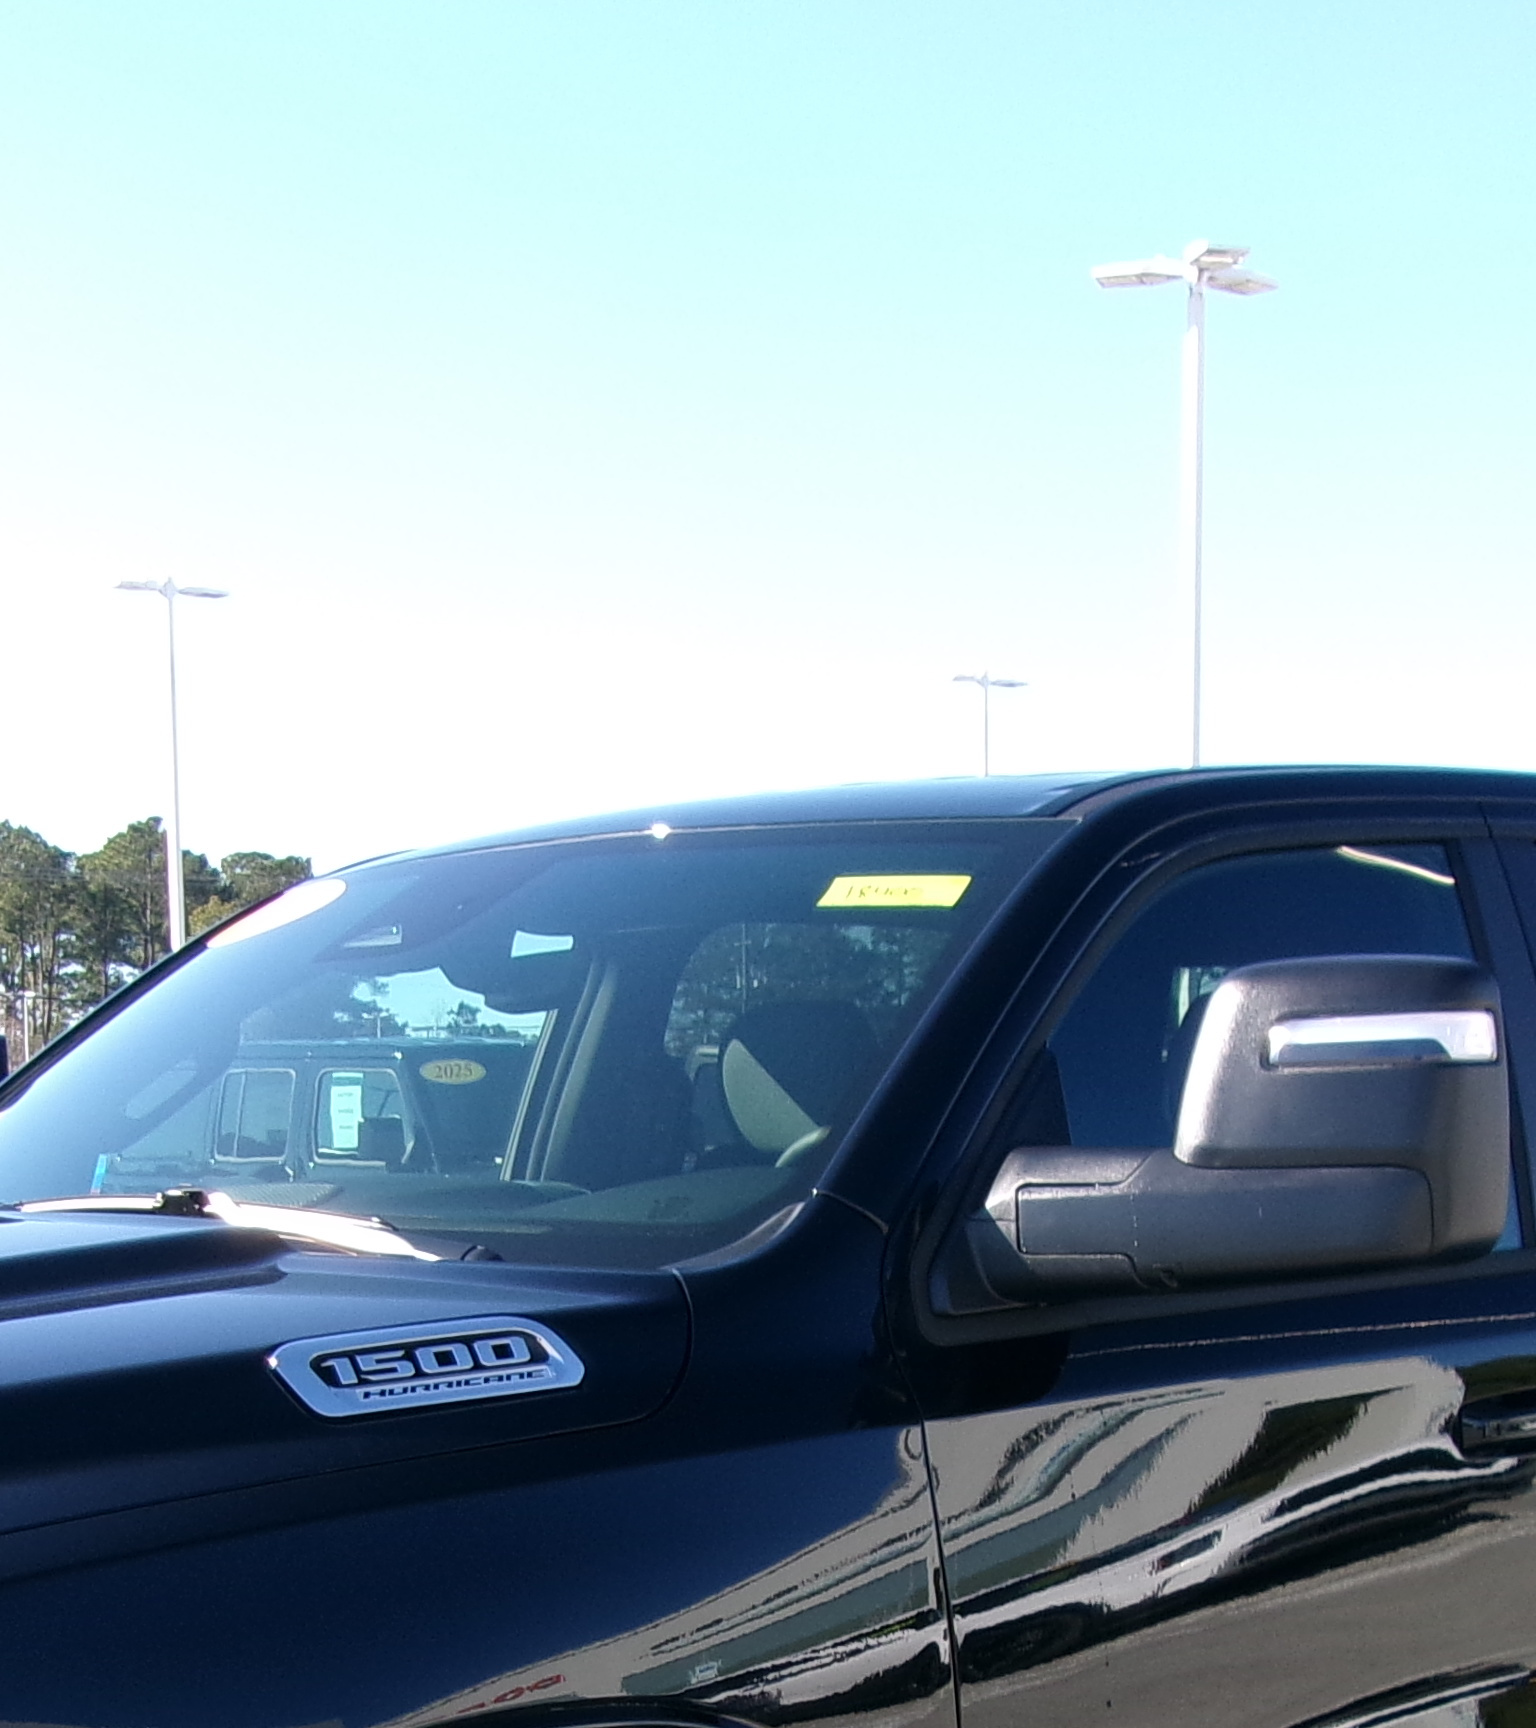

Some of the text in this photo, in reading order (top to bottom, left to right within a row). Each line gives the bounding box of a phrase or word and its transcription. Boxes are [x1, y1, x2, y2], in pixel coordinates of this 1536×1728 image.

[434, 1063, 474, 1080] 2025
[320, 1335, 532, 1386] 1500
[362, 1369, 548, 1400] HURRICANE
